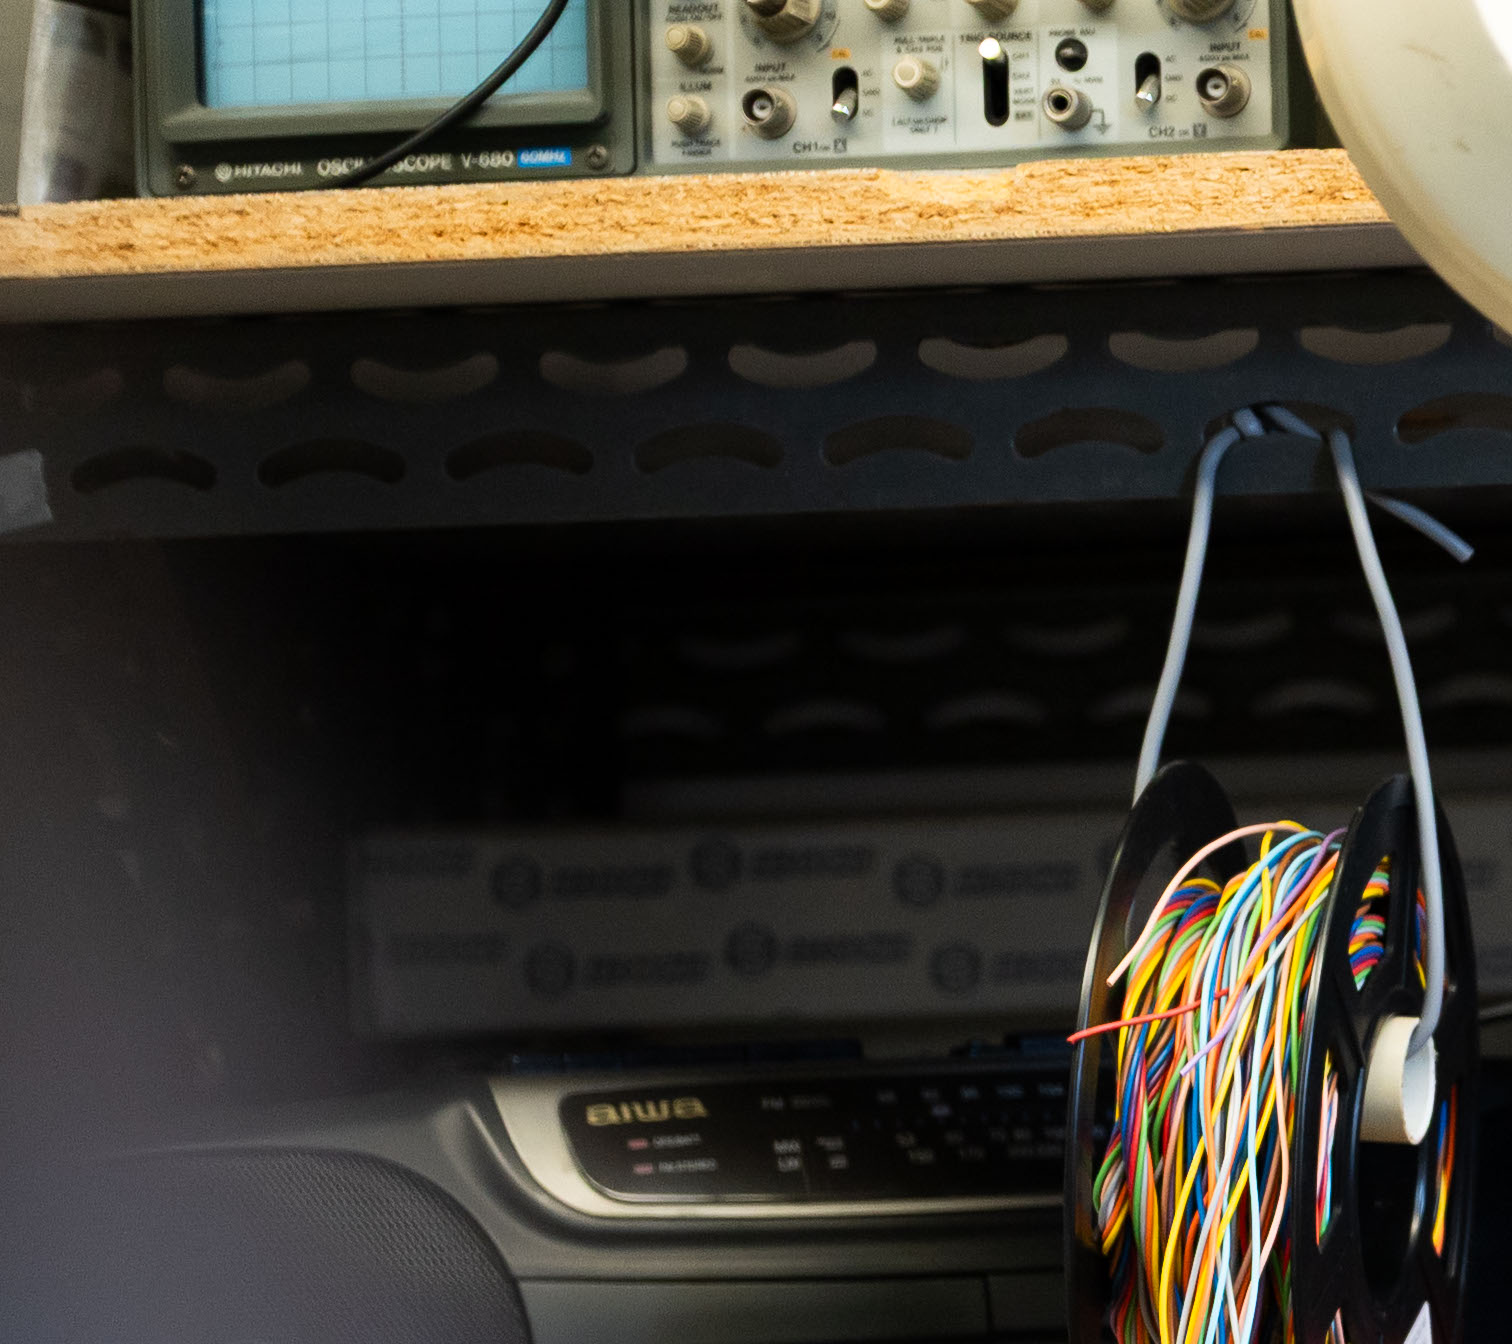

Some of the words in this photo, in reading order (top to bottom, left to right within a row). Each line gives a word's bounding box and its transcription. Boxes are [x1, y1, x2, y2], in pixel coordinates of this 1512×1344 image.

[234, 163, 303, 179] HITACHI
[461, 151, 515, 169] V-680
[586, 1096, 708, 1127] aiwa
